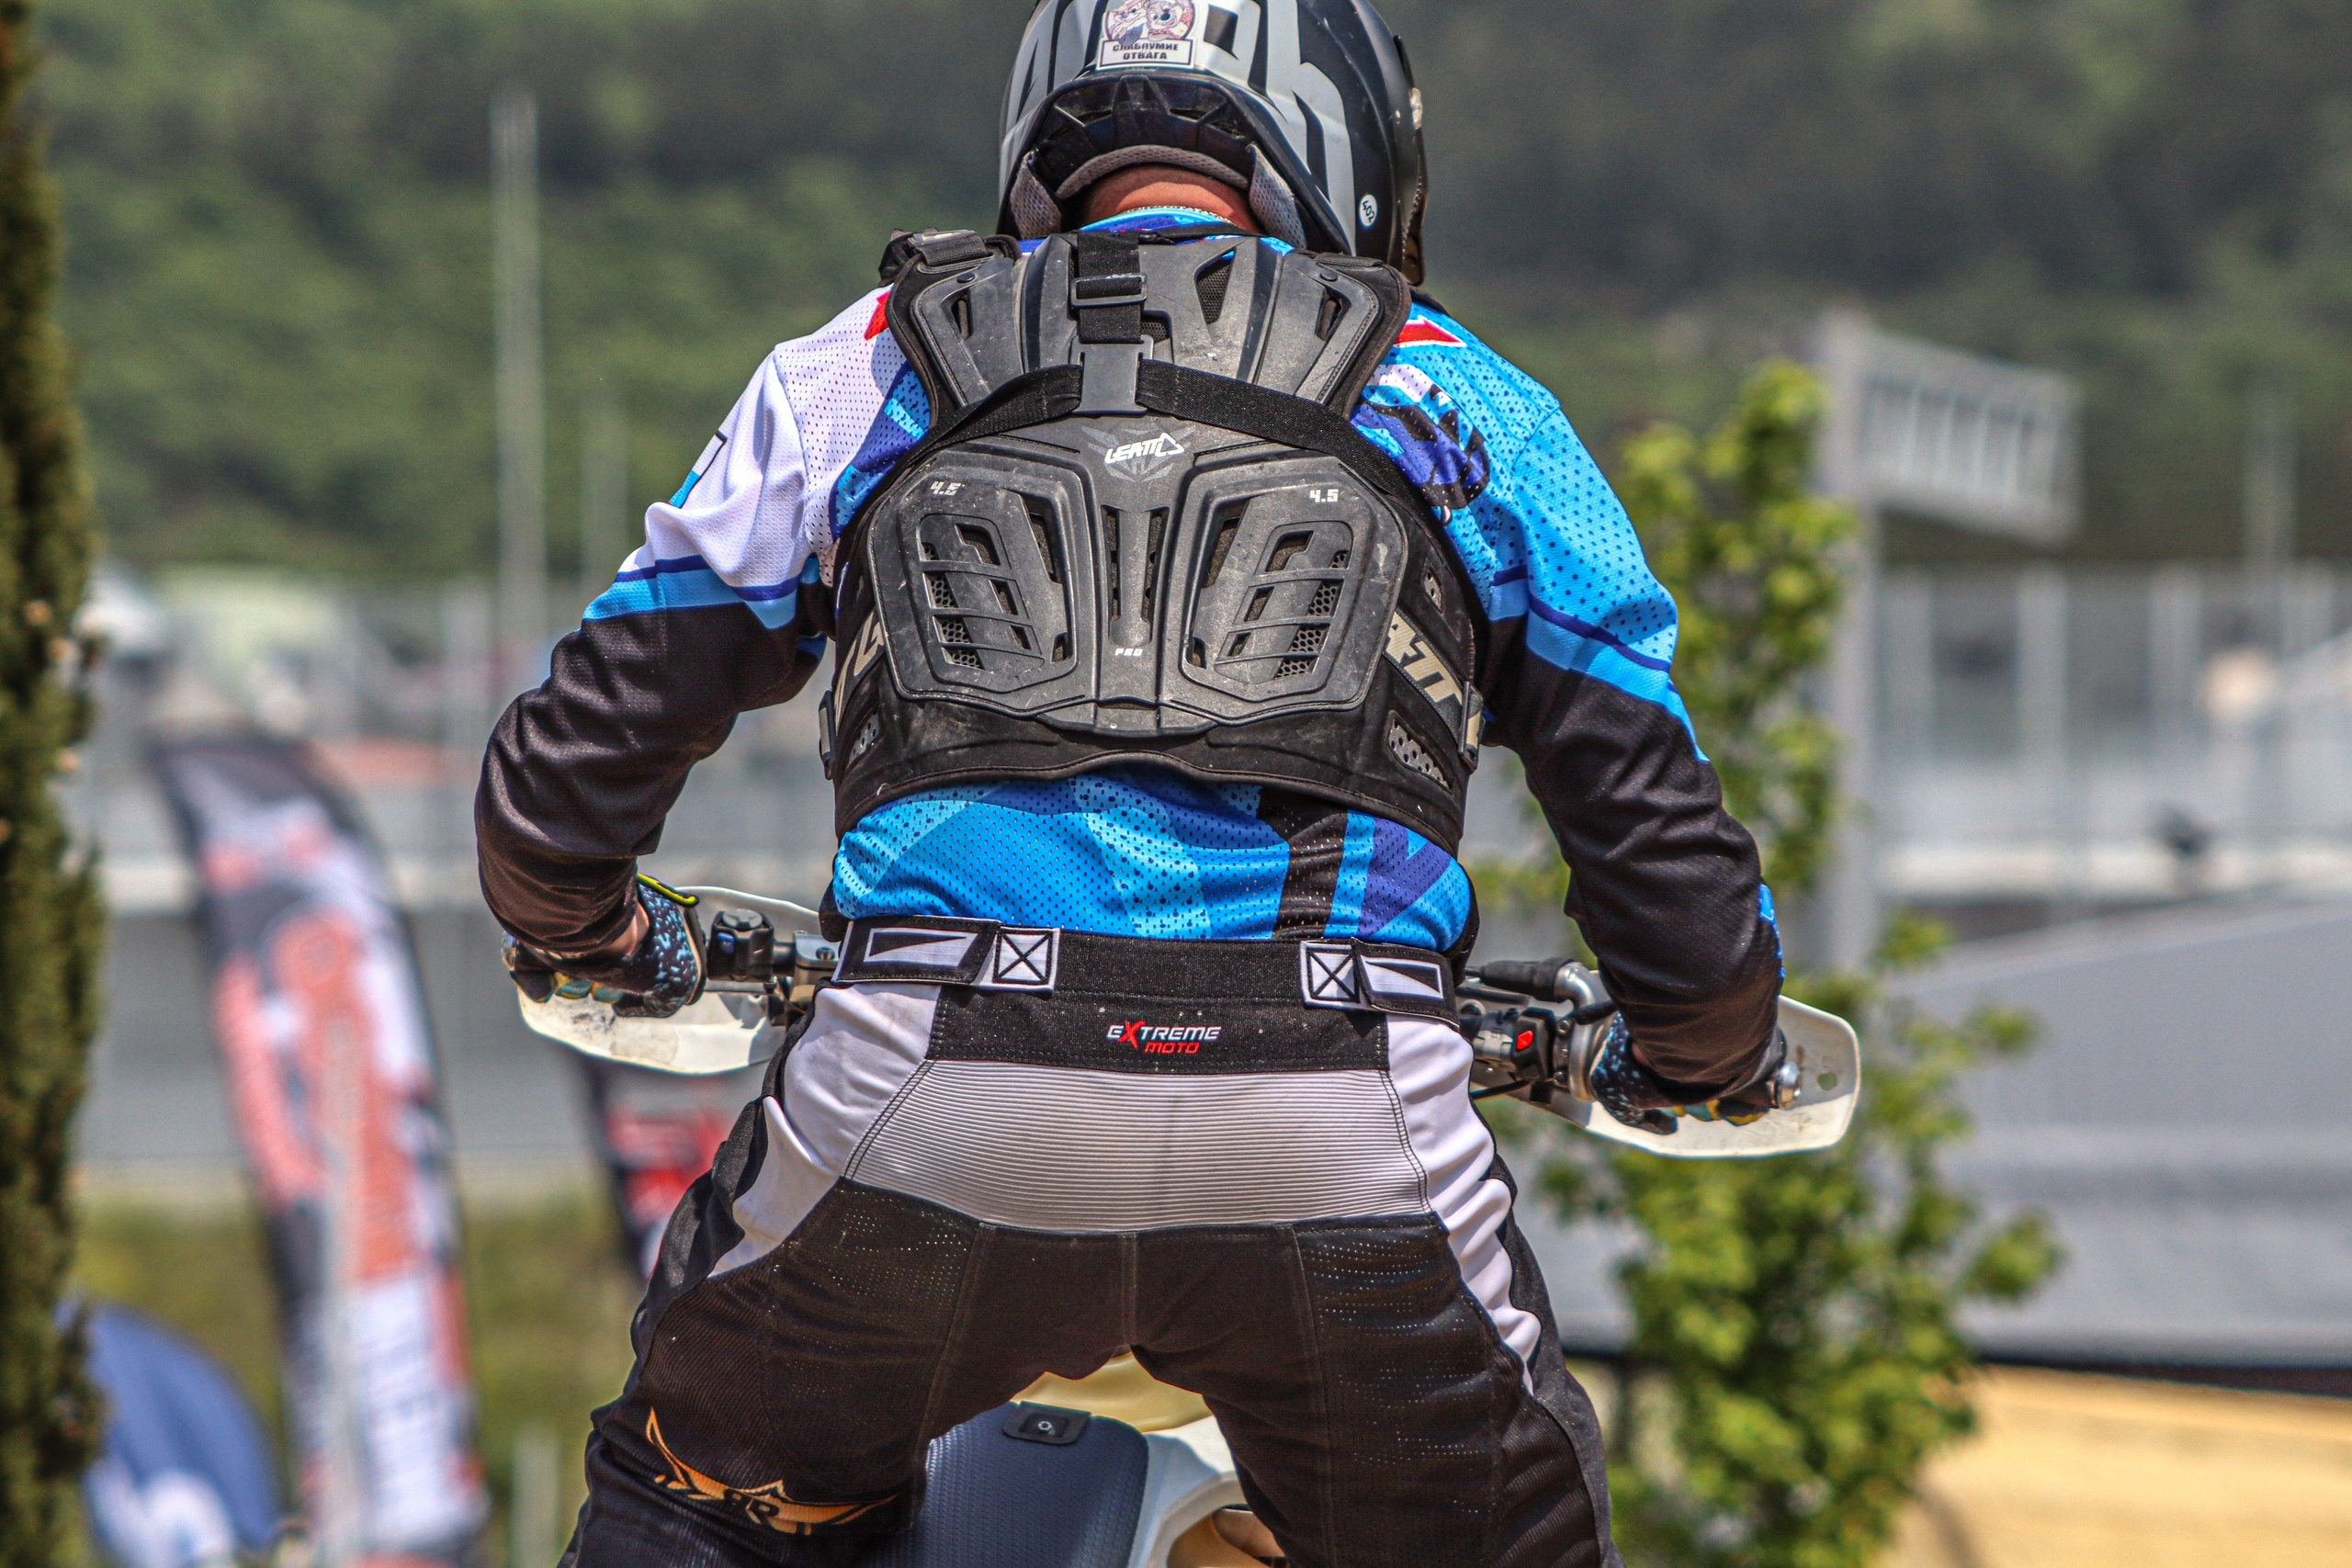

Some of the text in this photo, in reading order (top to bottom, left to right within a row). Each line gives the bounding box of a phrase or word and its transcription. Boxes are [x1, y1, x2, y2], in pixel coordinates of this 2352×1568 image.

[1123, 51, 1168, 61] ОТВАГА
[1104, 437, 1164, 464] LEATT
[930, 480, 962, 496] 4.5
[1309, 489, 1340, 502] 4.5
[1114, 648, 1144, 657] PRO
[1144, 1042, 1201, 1055] MOTO
